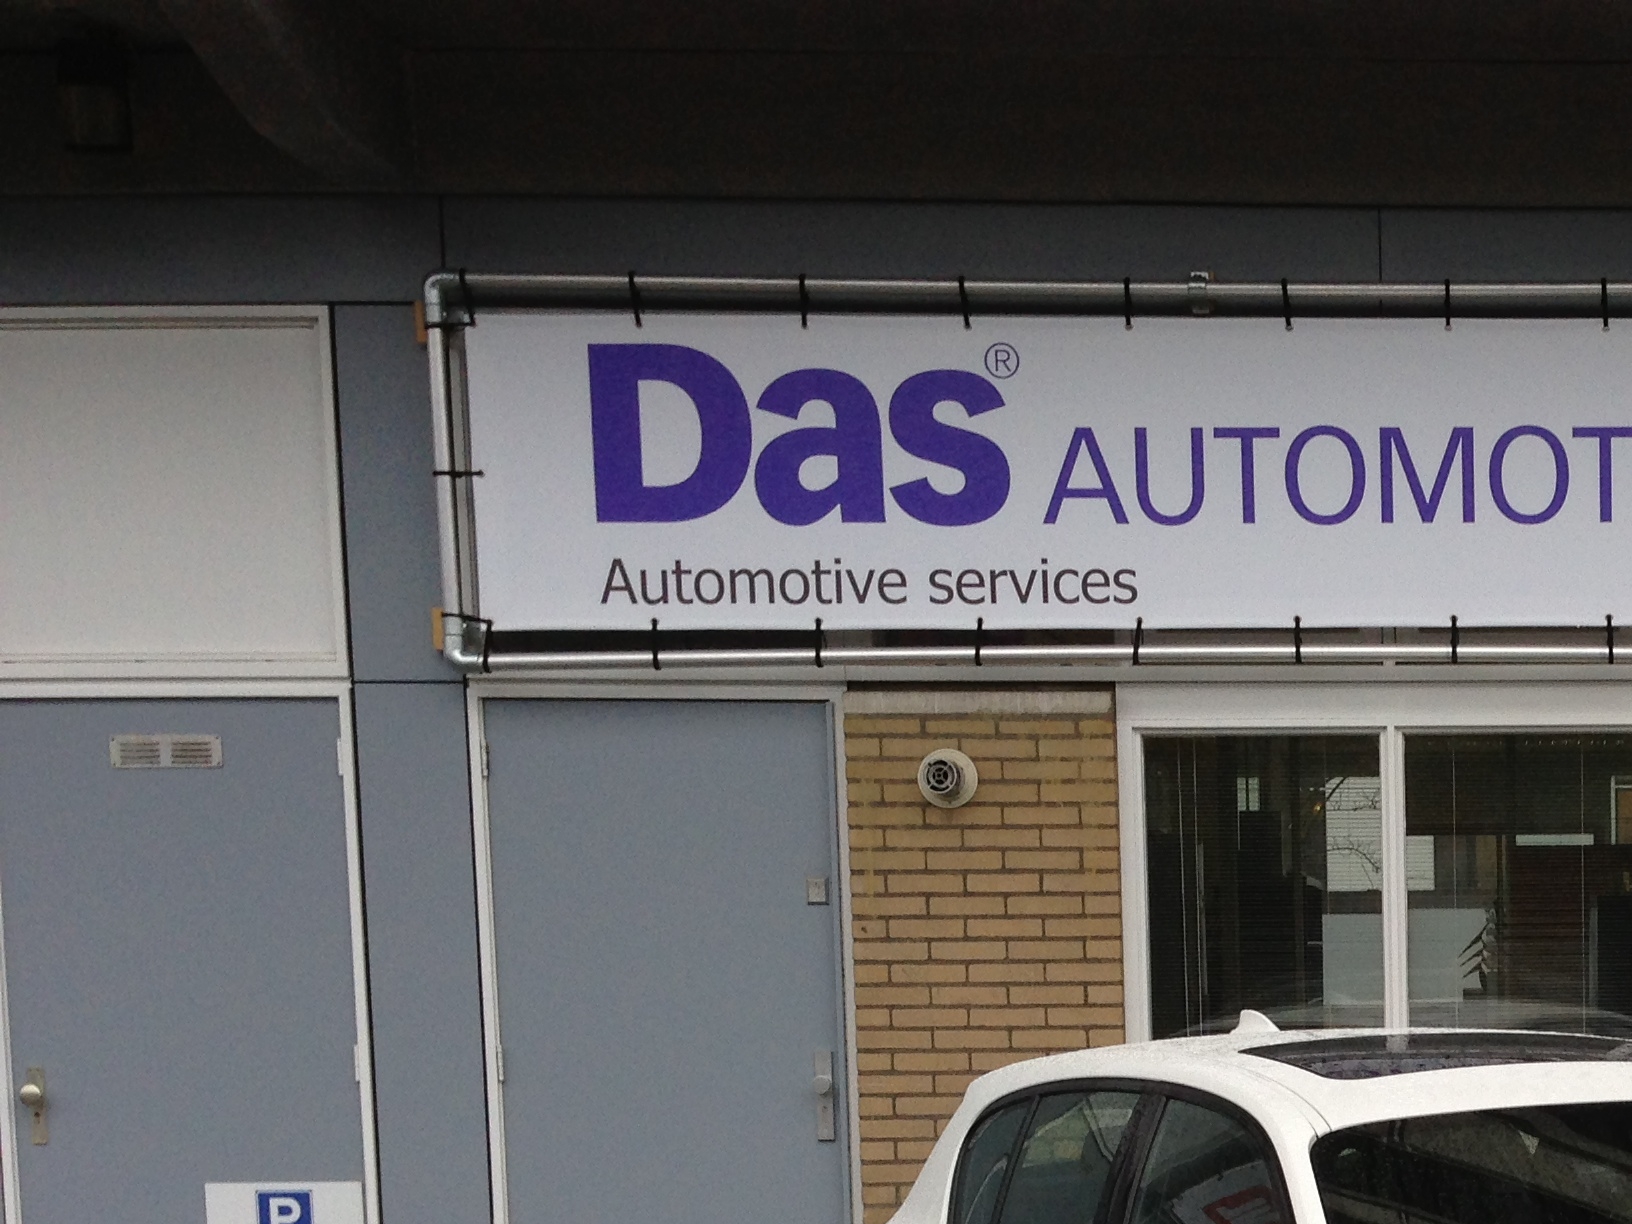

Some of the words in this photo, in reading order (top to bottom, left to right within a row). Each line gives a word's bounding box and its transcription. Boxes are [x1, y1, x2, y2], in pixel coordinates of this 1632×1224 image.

[586, 342, 1012, 527] Das
[600, 557, 908, 606] Automotive
[928, 557, 1139, 606] services
